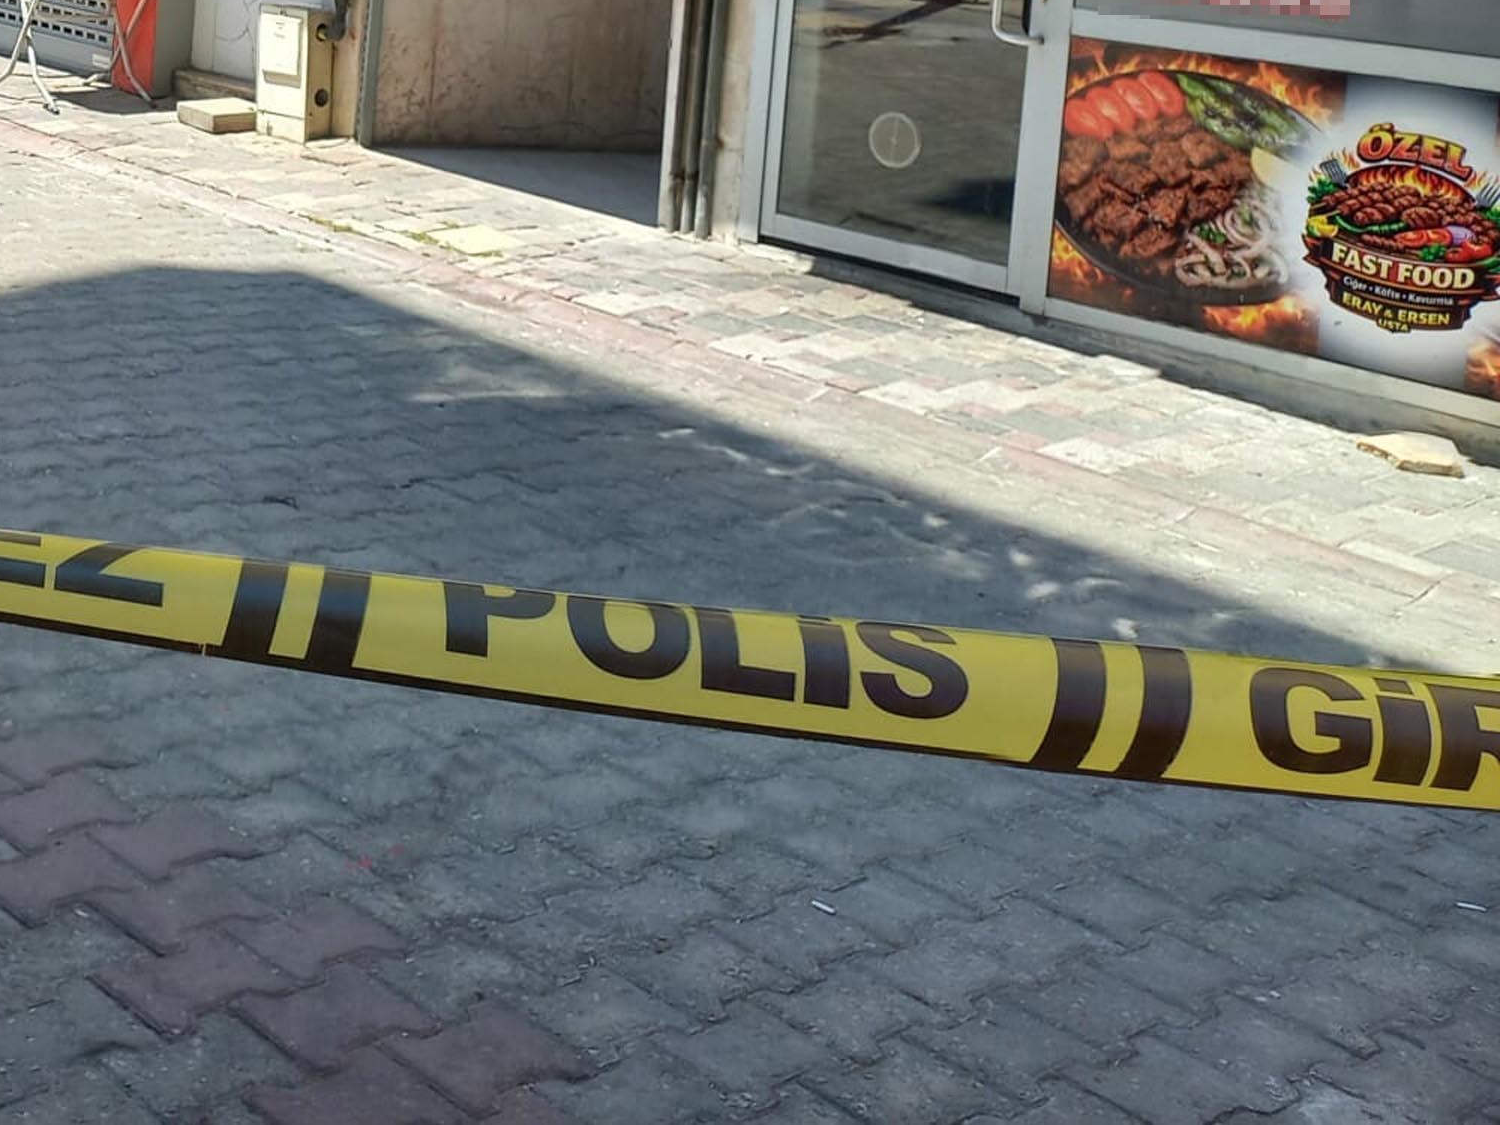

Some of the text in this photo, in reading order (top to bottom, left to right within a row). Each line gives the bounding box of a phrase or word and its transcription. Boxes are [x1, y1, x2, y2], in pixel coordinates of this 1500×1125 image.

[1358, 122, 1473, 182] ÖZEL
[1332, 242, 1475, 289] FAST FOOD
[1342, 291, 1383, 315] ERAY
[1397, 308, 1450, 325] ERSEN
[1378, 318, 1409, 331] USTA
